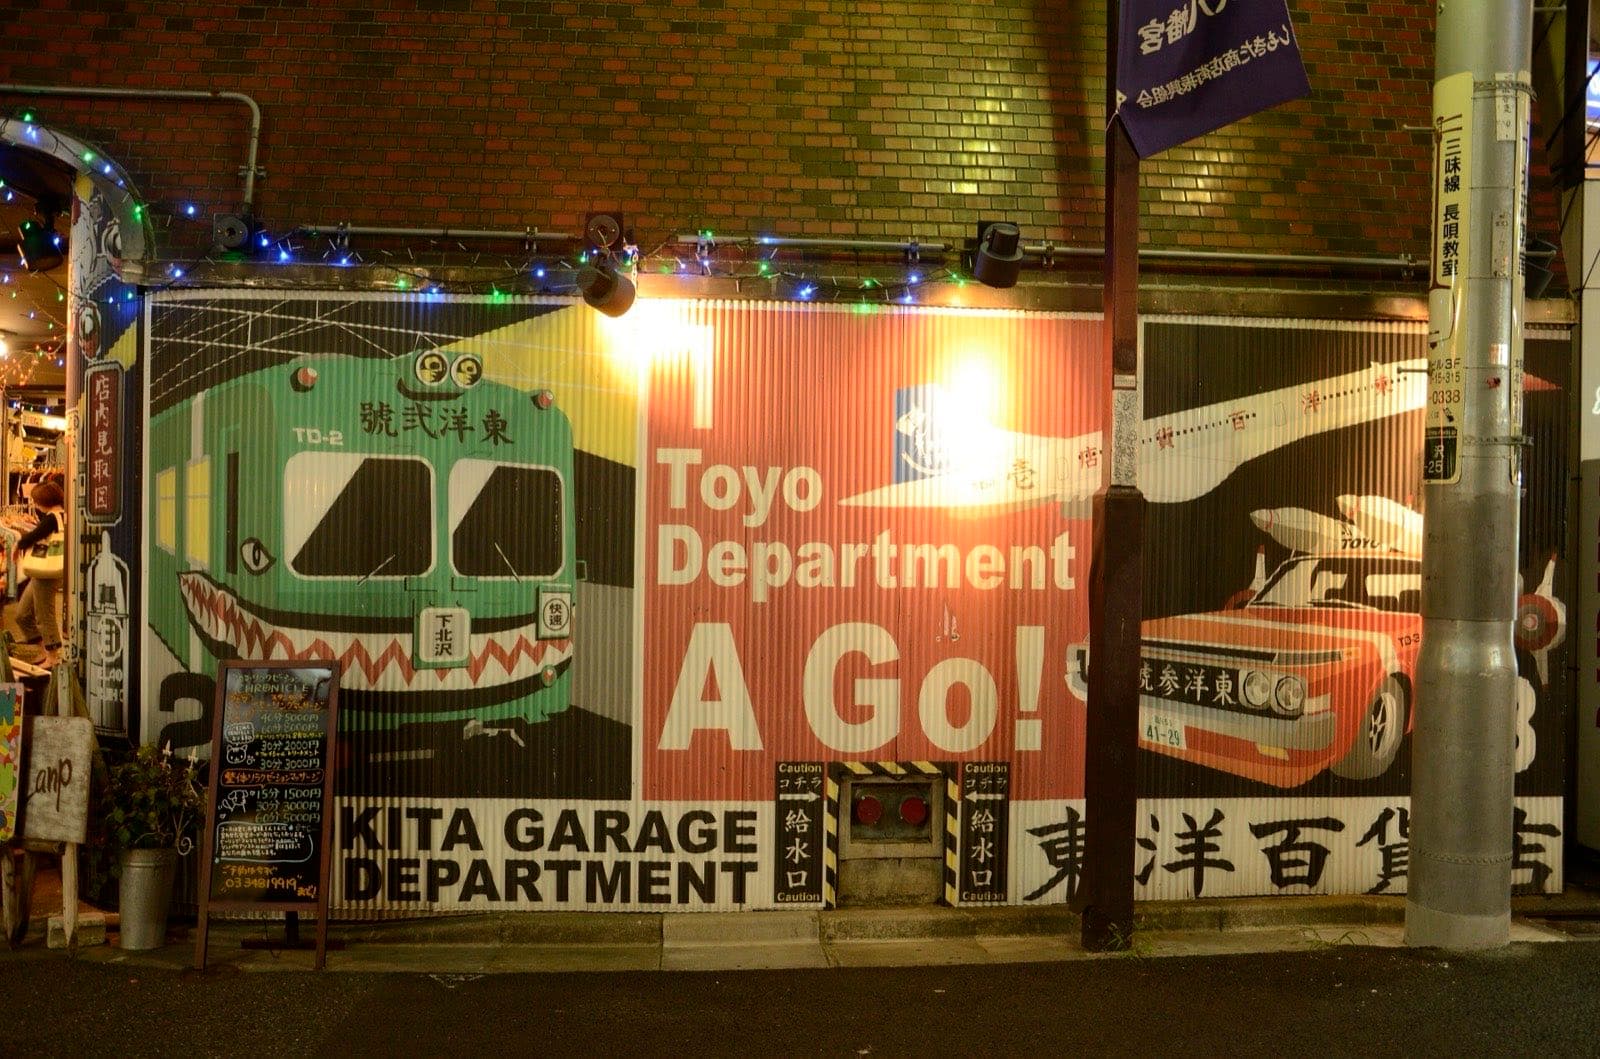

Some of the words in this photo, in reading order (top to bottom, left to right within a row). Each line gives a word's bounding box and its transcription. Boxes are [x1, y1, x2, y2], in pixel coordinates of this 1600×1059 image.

[1444, 138, 1462, 193] 三味線
[1441, 203, 1460, 277] 長唄教室
[292, 427, 343, 446] TD-2
[657, 448, 823, 527] Toyo
[657, 524, 1076, 602] Department
[549, 603, 562, 626] 快速
[435, 614, 453, 656] 下北沢
[658, 622, 764, 751] A
[803, 622, 1045, 753] Go!
[284, 740, 319, 750] 2000円
[1146, 724, 1180, 747] 41-29
[284, 758, 320, 770] 3000円
[778, 763, 822, 774] Caution
[964, 763, 1008, 774] Caution
[284, 788, 321, 799] 1500円
[779, 776, 822, 789] コチラ
[965, 776, 1007, 789] コチラ
[341, 806, 484, 852] KITA
[503, 807, 758, 854] GARAGE
[784, 808, 812, 888] 給水口
[970, 808, 995, 888] 給水口
[344, 857, 759, 904] DEPARTMENT
[777, 892, 820, 902] Caution
[962, 891, 1004, 902] Caution
